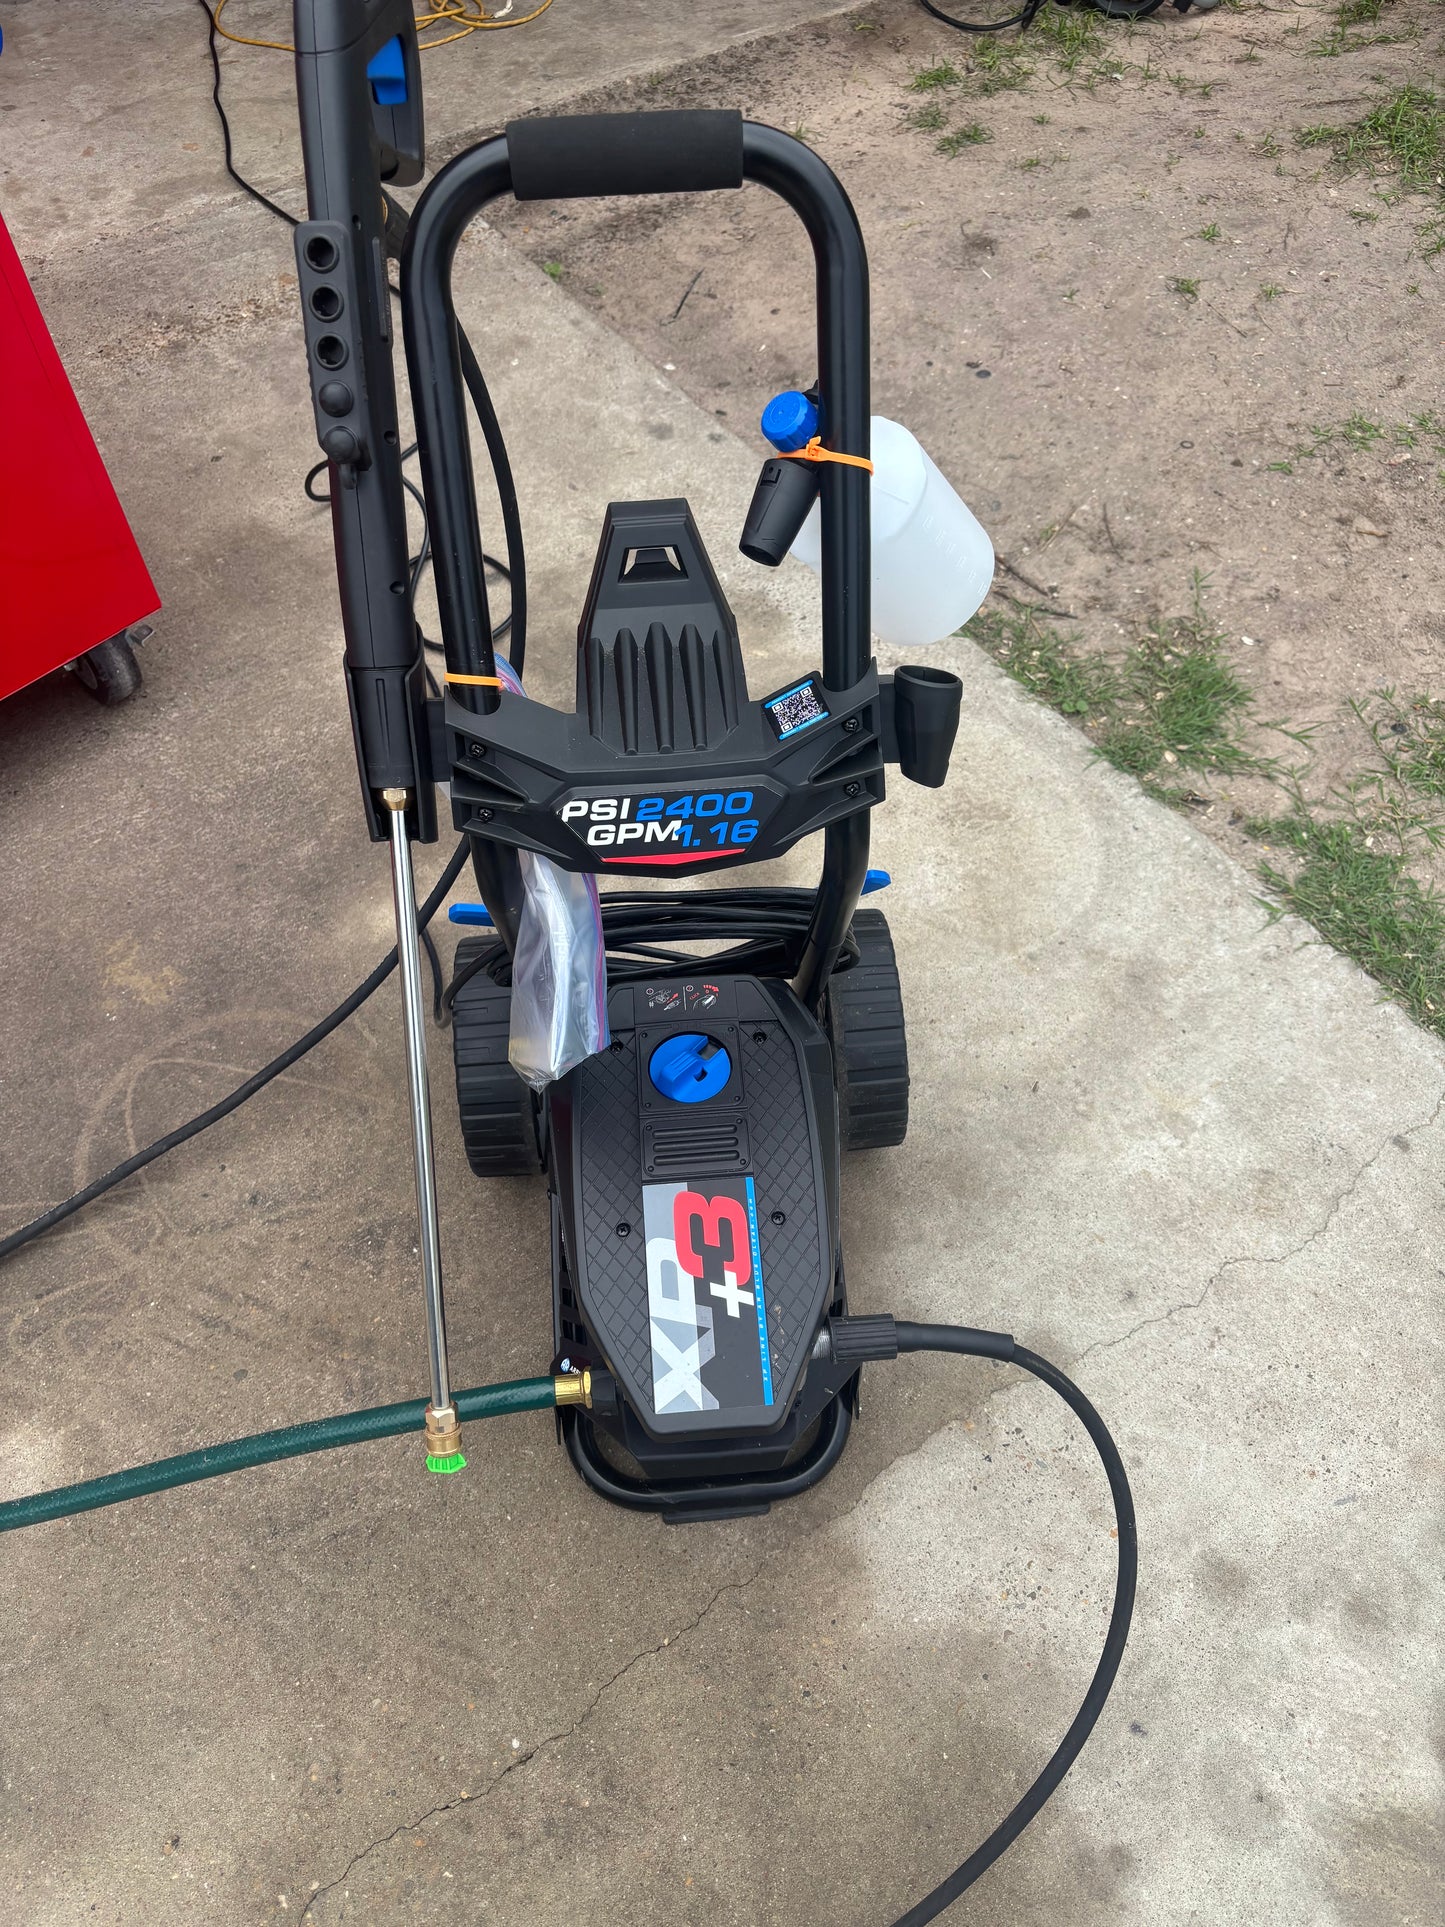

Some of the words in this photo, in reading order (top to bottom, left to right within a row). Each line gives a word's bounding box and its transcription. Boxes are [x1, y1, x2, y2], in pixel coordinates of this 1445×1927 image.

[561, 798, 631, 823] PSI
[635, 791, 753, 822] 2400
[587, 820, 682, 846] GPM
[645, 1237, 719, 1414] XP
